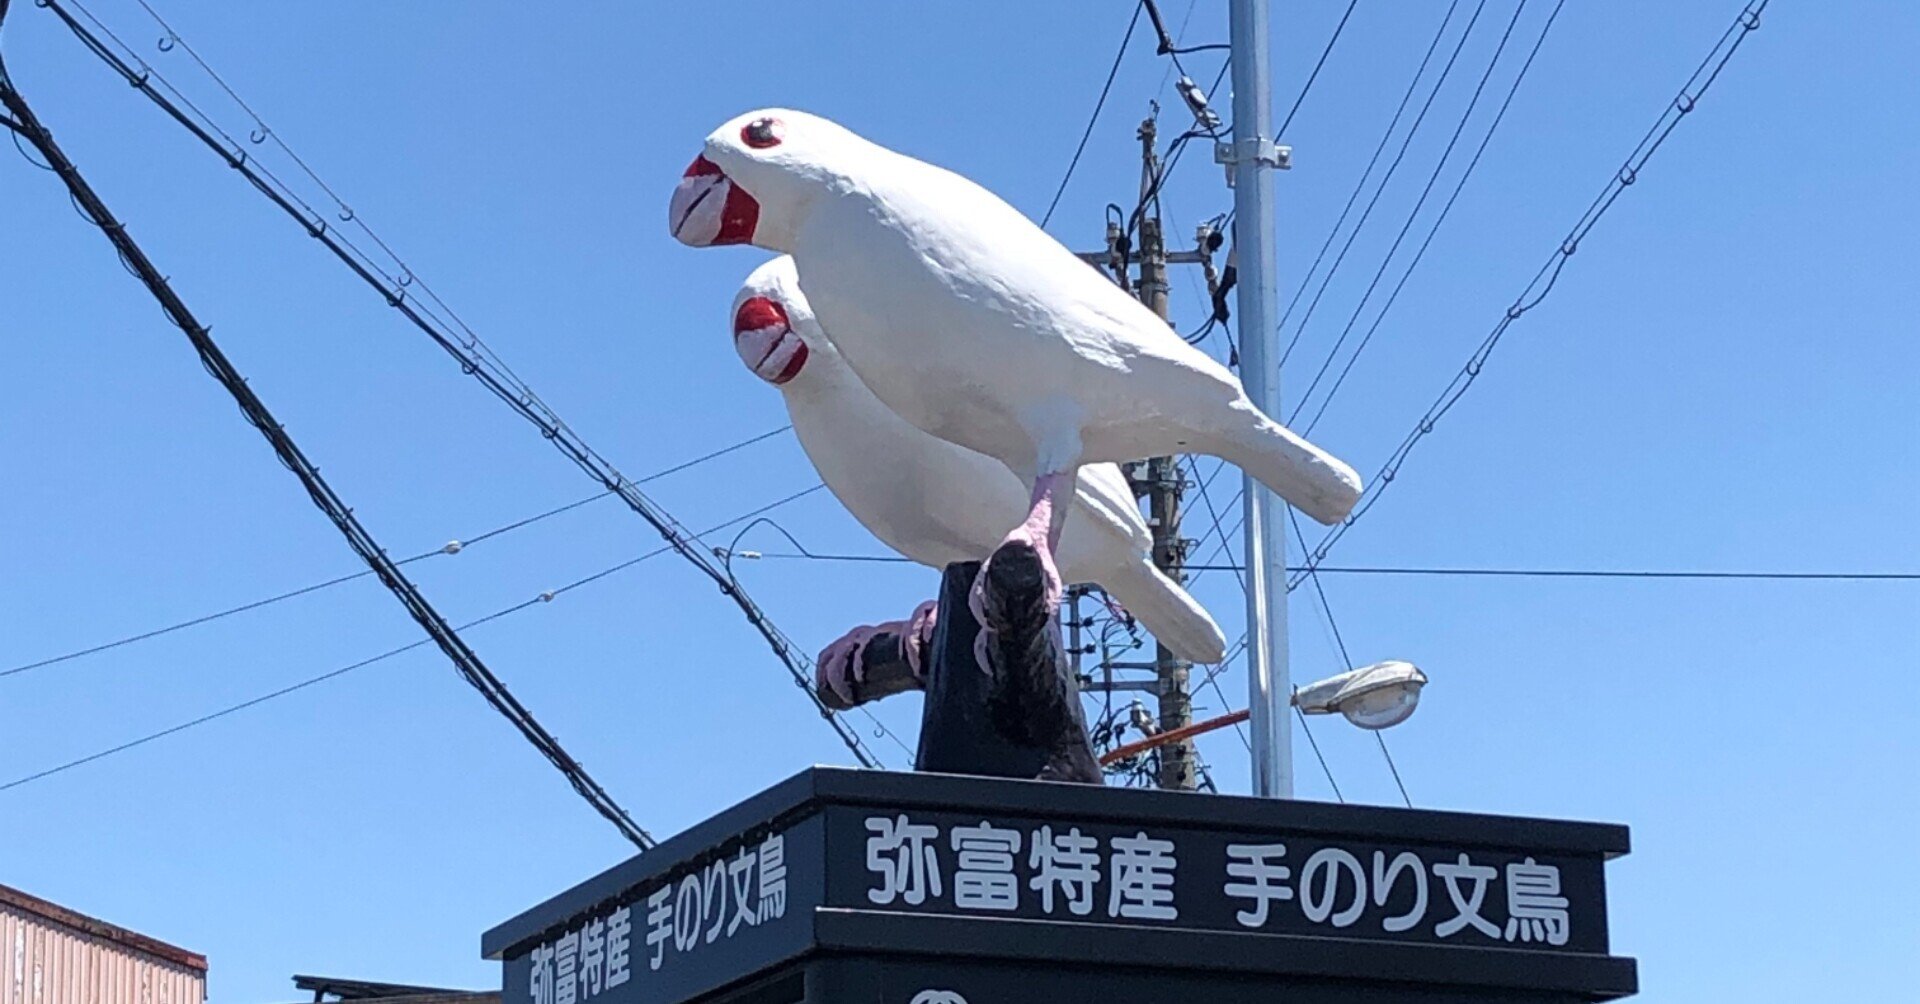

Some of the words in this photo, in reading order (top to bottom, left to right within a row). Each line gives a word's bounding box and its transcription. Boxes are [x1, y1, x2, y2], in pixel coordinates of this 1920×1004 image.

[530, 905, 632, 1004] 弥富特産
[646, 832, 787, 971] 手のり文鳥
[865, 814, 1178, 921] 弥富特産
[1224, 843, 1570, 946] 手のり文鳥
